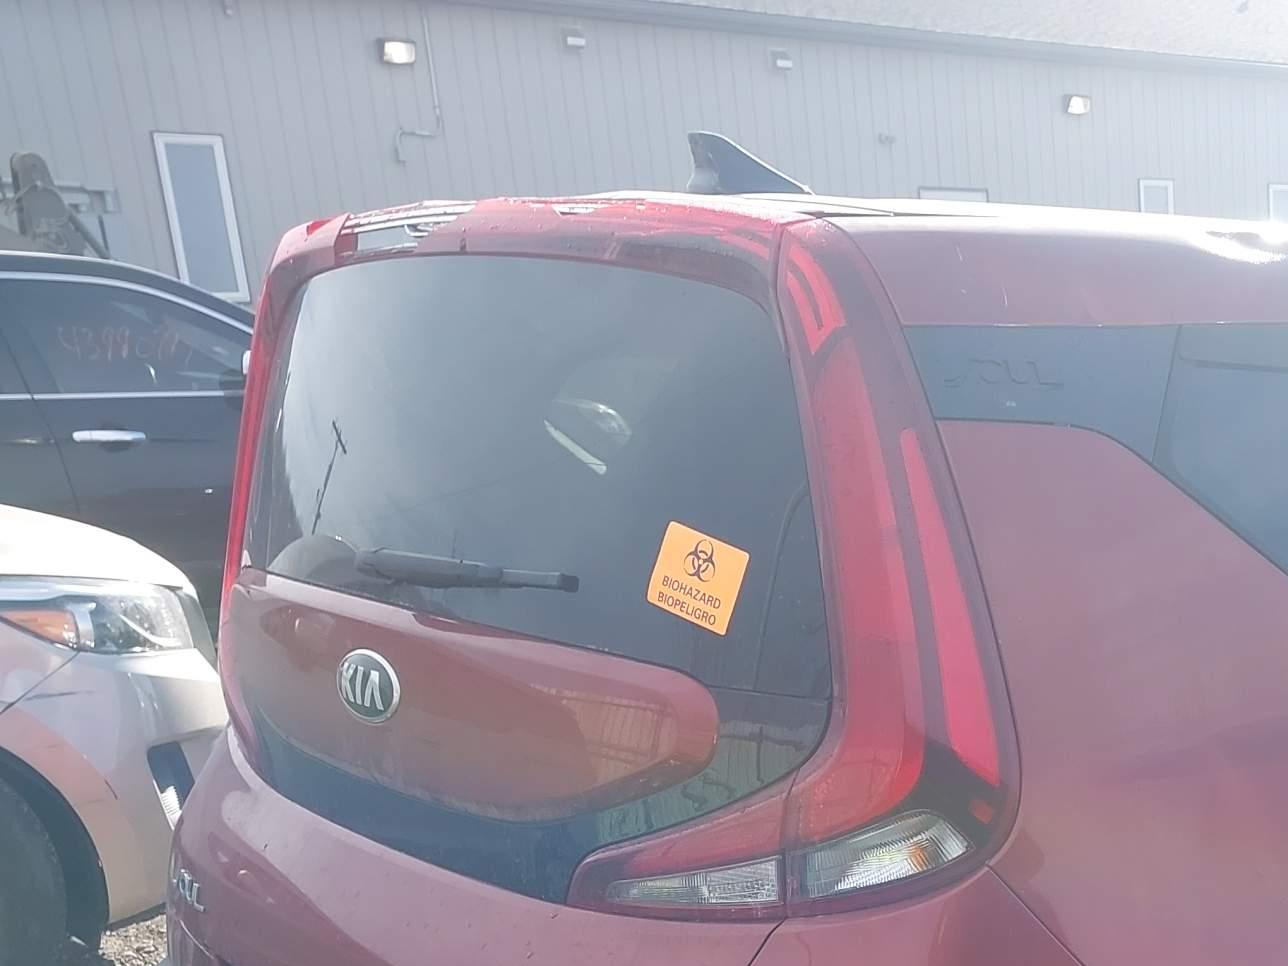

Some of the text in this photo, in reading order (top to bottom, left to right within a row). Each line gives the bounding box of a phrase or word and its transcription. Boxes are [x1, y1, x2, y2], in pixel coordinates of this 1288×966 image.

[657, 591, 717, 626] BIOPELIGRO
[661, 575, 722, 610] BIOHAZARD
[340, 661, 385, 712] KIA
